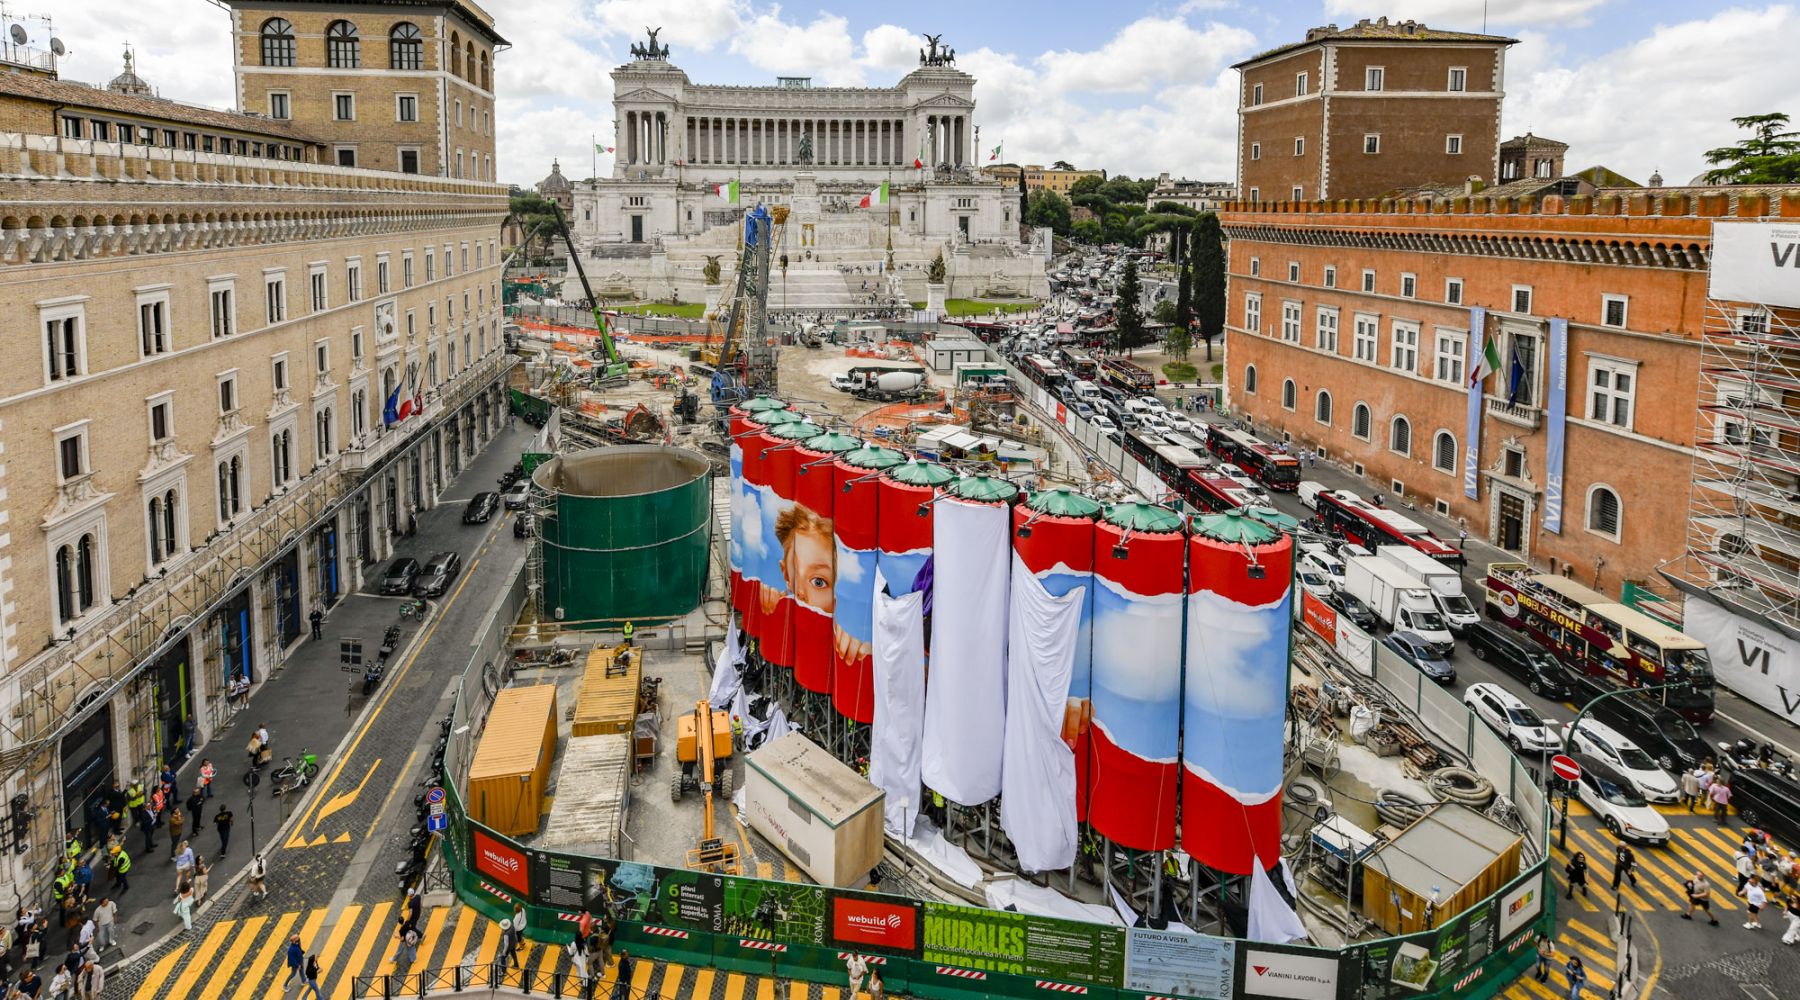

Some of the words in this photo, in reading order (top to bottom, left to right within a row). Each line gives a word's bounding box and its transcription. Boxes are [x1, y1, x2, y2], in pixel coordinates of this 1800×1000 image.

[1464, 446, 1478, 489] VIVE
[1545, 472, 1562, 521] VIVE
[1550, 610, 1583, 635] ROME
[483, 849, 510, 867] webuild
[668, 884, 680, 897] 6
[669, 901, 679, 915] 3
[713, 903, 722, 931] ROMA
[847, 914, 886, 926] webuild
[814, 915, 823, 944] ROMA
[924, 915, 1025, 957] MURALES
[1134, 932, 1162, 941] FUTURO
[1169, 936, 1188, 944] VISTA
[940, 944, 994, 958] contemporanea
[1002, 953, 1024, 962] metro
[1440, 935, 1453, 953] 66
[1219, 968, 1231, 998] ROMA
[1267, 971, 1292, 980] VIANINI
[1293, 974, 1317, 982] LAVORI
